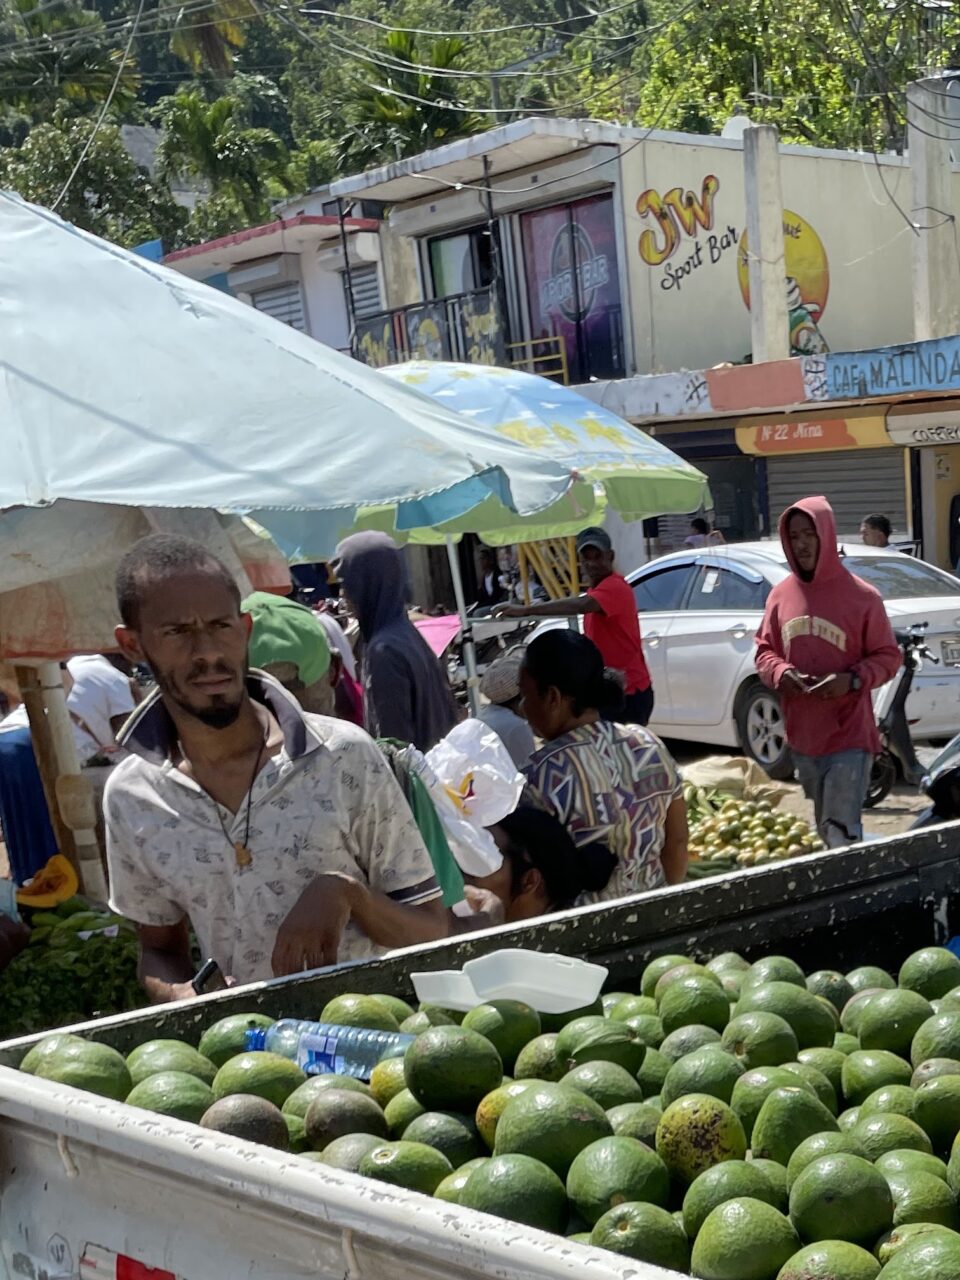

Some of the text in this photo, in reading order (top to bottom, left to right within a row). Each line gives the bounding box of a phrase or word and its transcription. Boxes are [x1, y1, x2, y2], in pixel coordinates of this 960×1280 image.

[636, 174, 720, 266] JW
[660, 246, 703, 290] Sport
[709, 225, 739, 264] Bar
[774, 424, 789, 441] 22
